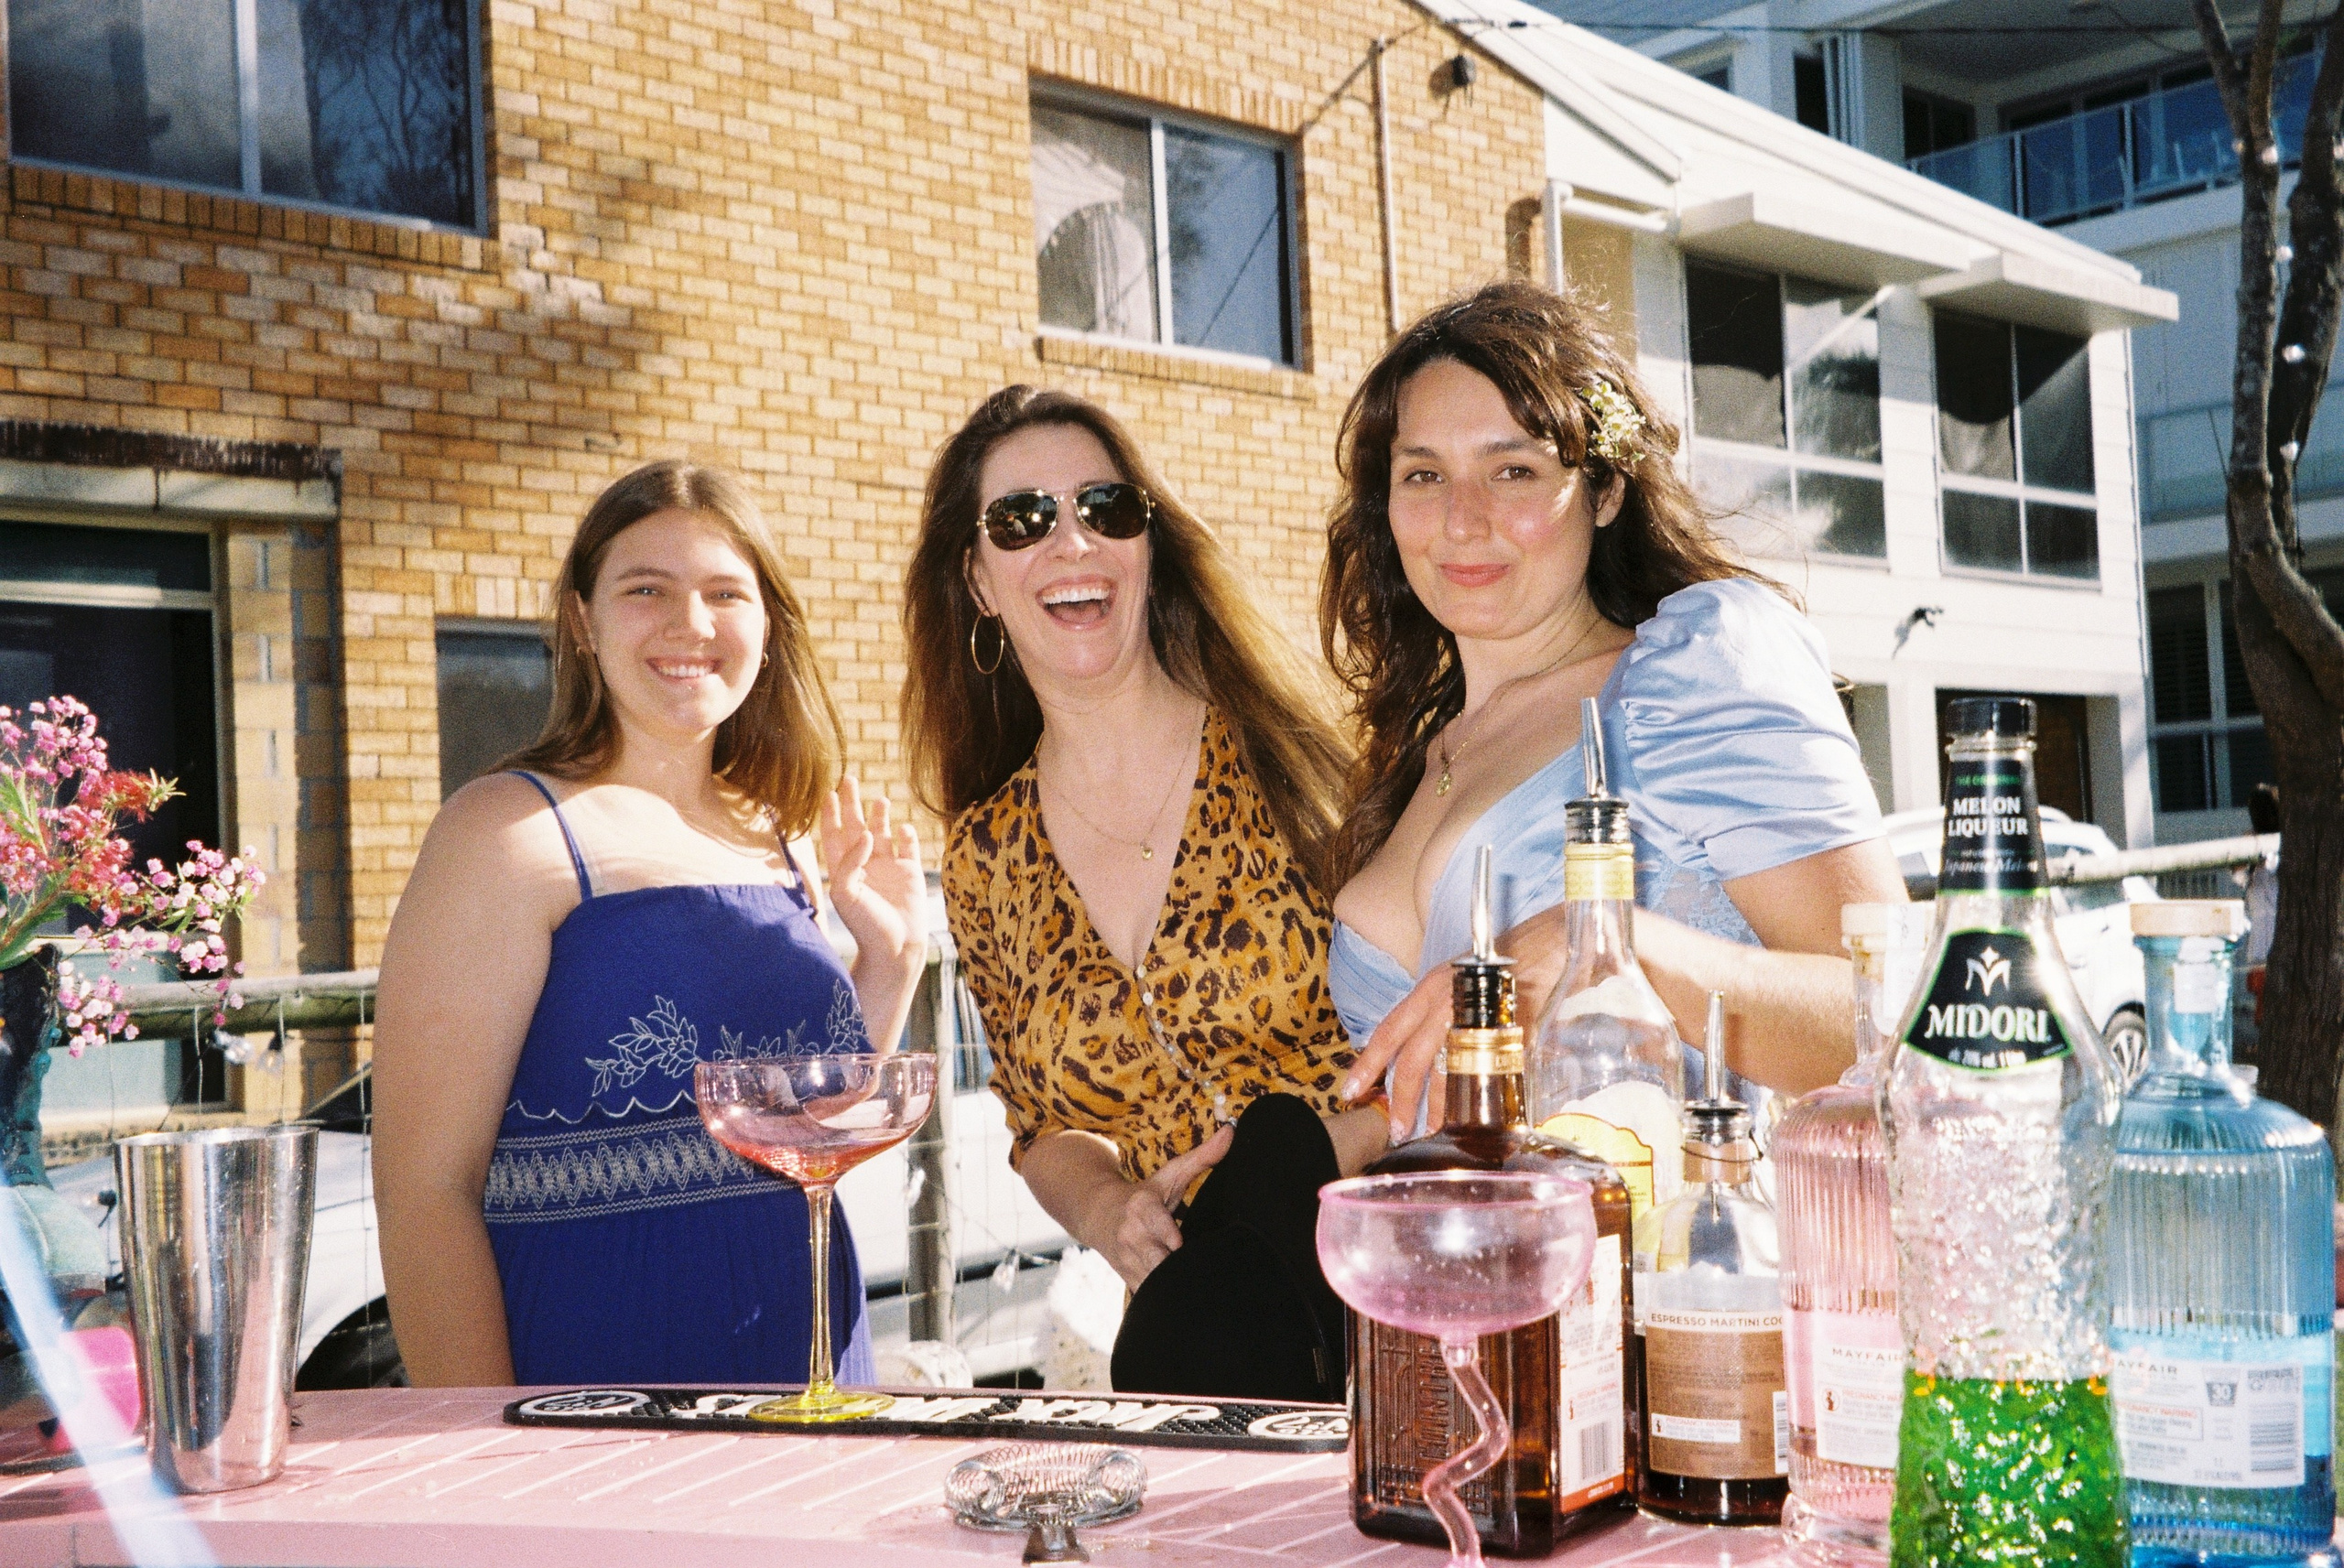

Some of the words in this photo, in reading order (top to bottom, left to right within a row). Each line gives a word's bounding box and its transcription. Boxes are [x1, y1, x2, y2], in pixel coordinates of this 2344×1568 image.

[1952, 795, 2022, 816] MELON
[1947, 816, 2029, 838] LIQUEUR
[1923, 1002, 2049, 1044] MIDORI
[1651, 1313, 1707, 1326] ESPRESSO
[1709, 1315, 1760, 1327] MARTINI
[2117, 1359, 2178, 1374] AYFAIR
